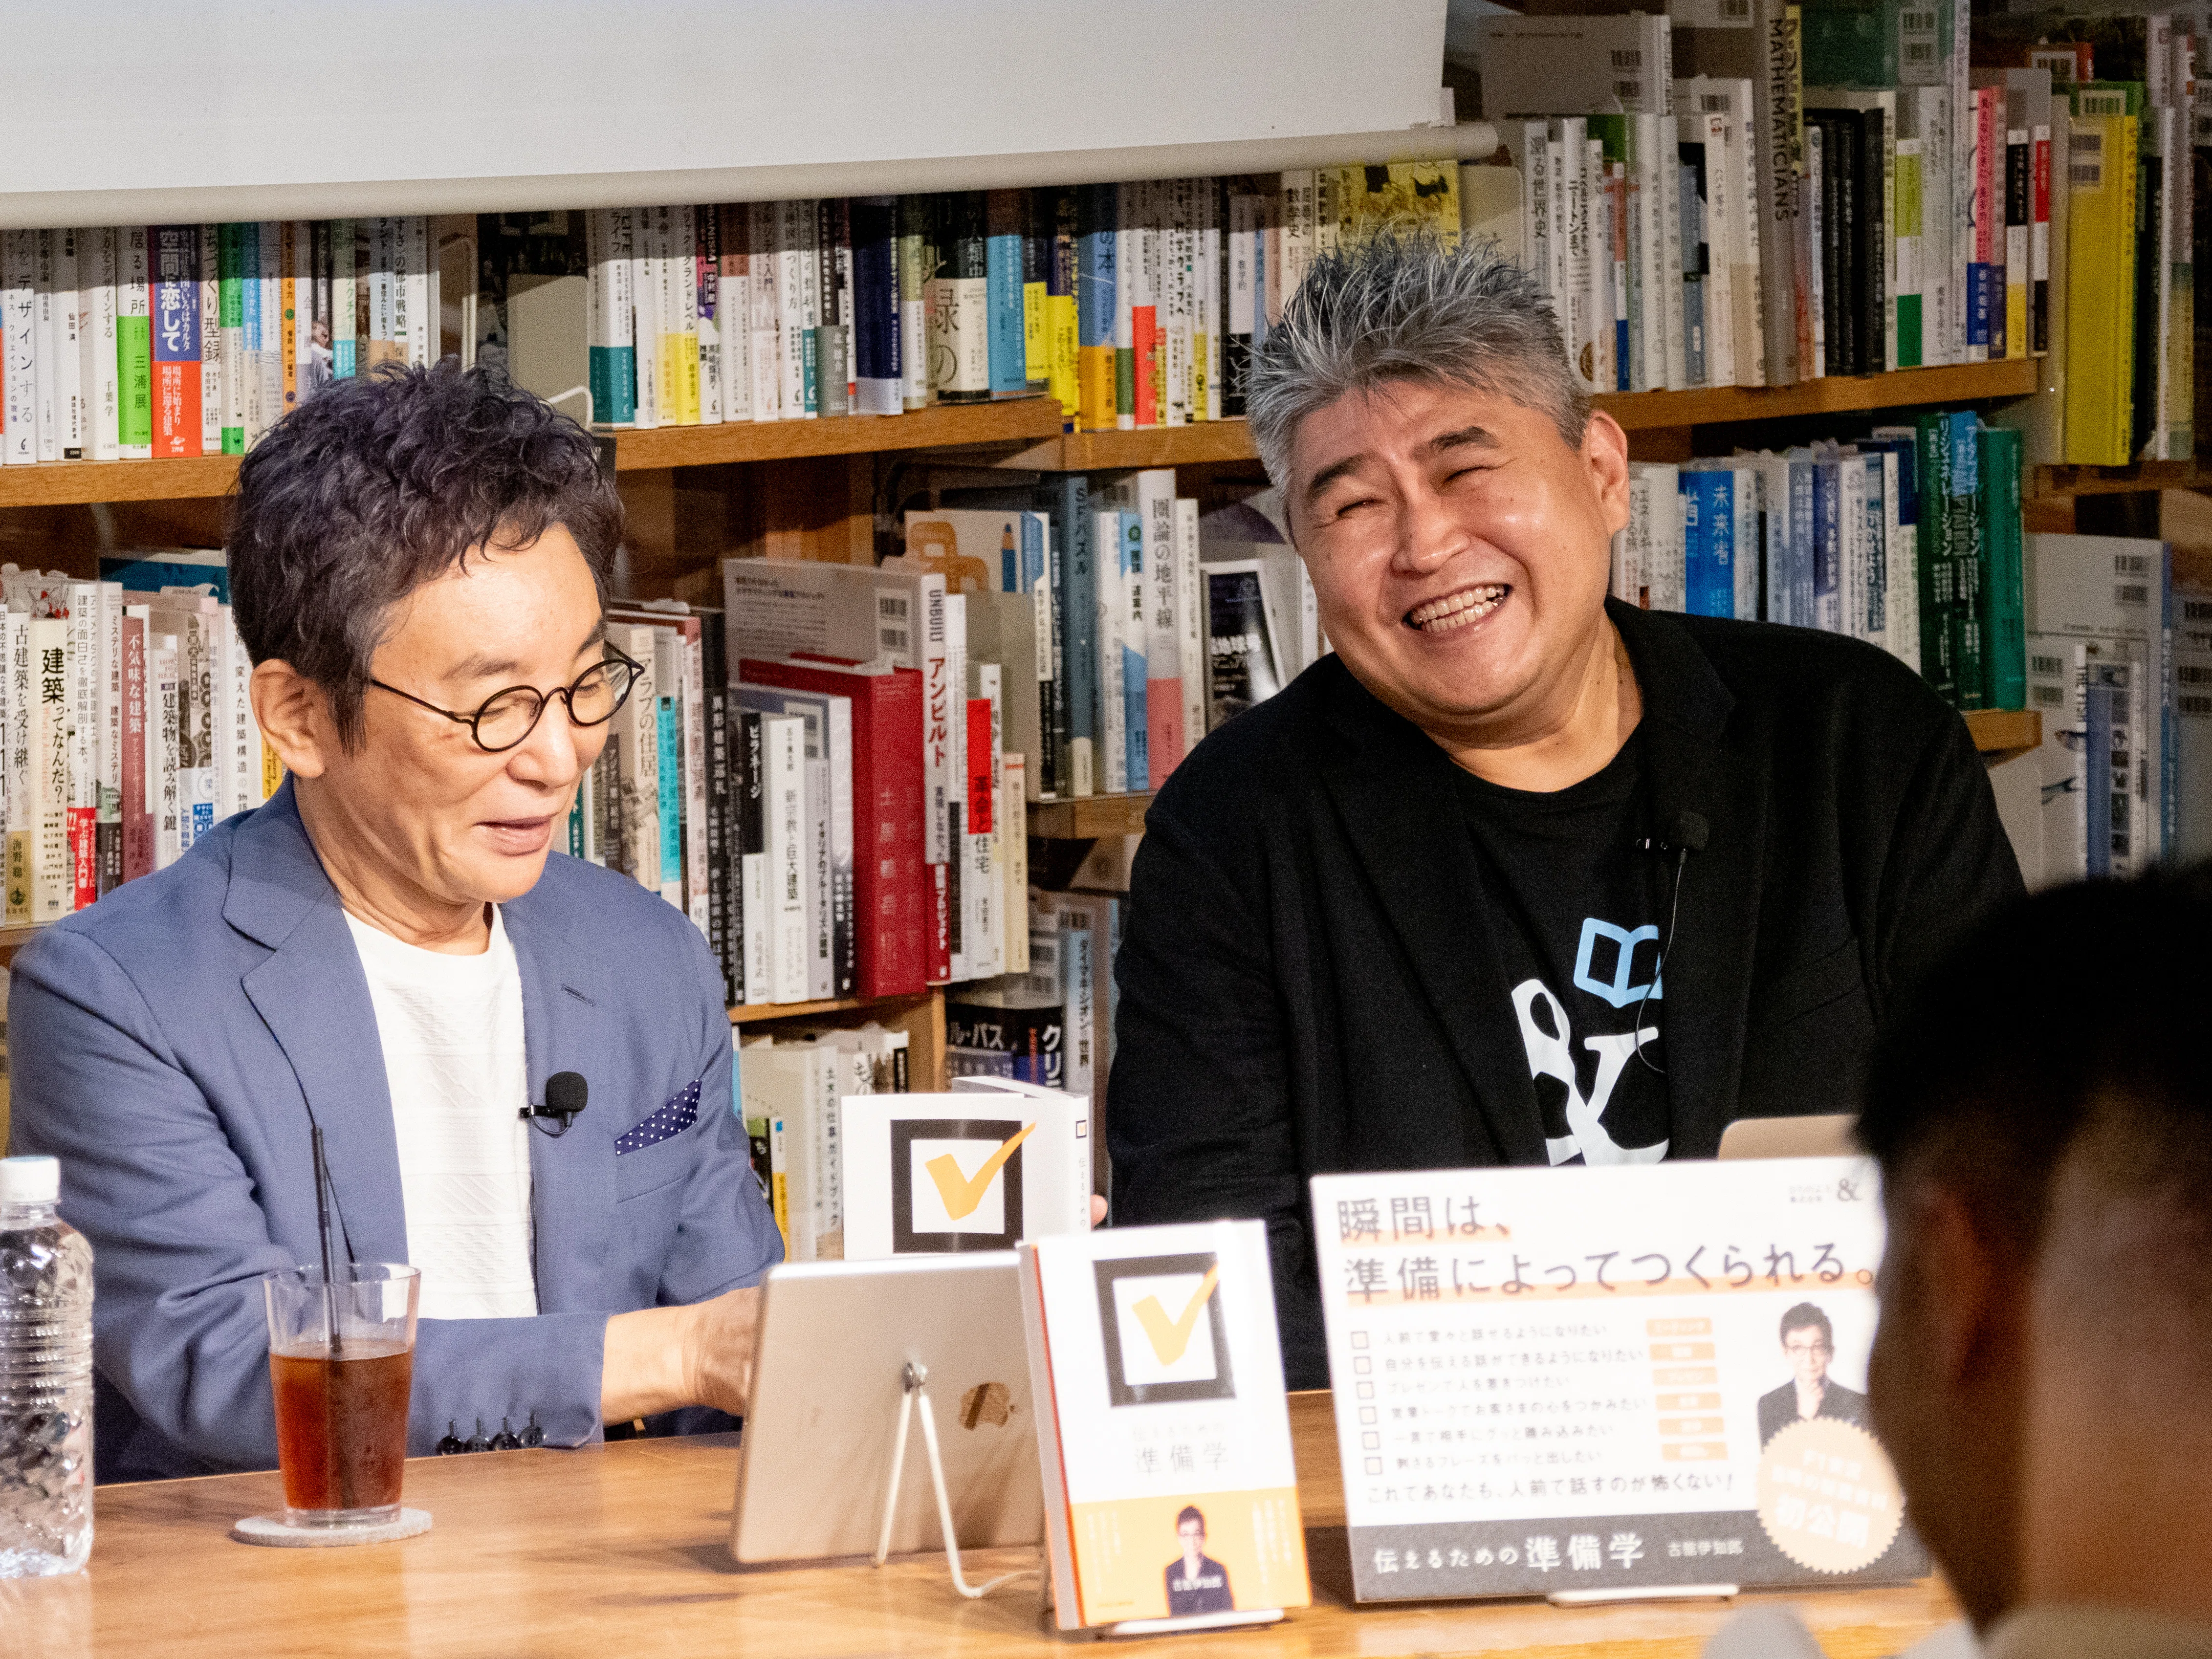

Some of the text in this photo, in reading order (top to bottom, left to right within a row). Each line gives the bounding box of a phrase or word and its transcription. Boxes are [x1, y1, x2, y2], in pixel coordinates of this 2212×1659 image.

[1770, 19, 1789, 221] MATHEMATICIANS
[159, 229, 180, 352] 空間に恋して
[133, 355, 146, 409] 三浦展
[14, 624, 29, 785] 古建築を受け継ぐ
[128, 635, 142, 733] 不気味な建築
[1337, 1195, 1511, 1242] 瞬間は、
[1345, 1242, 1875, 1303] 準備によってつくられる。
[1134, 1441, 1229, 1477] 準備学
